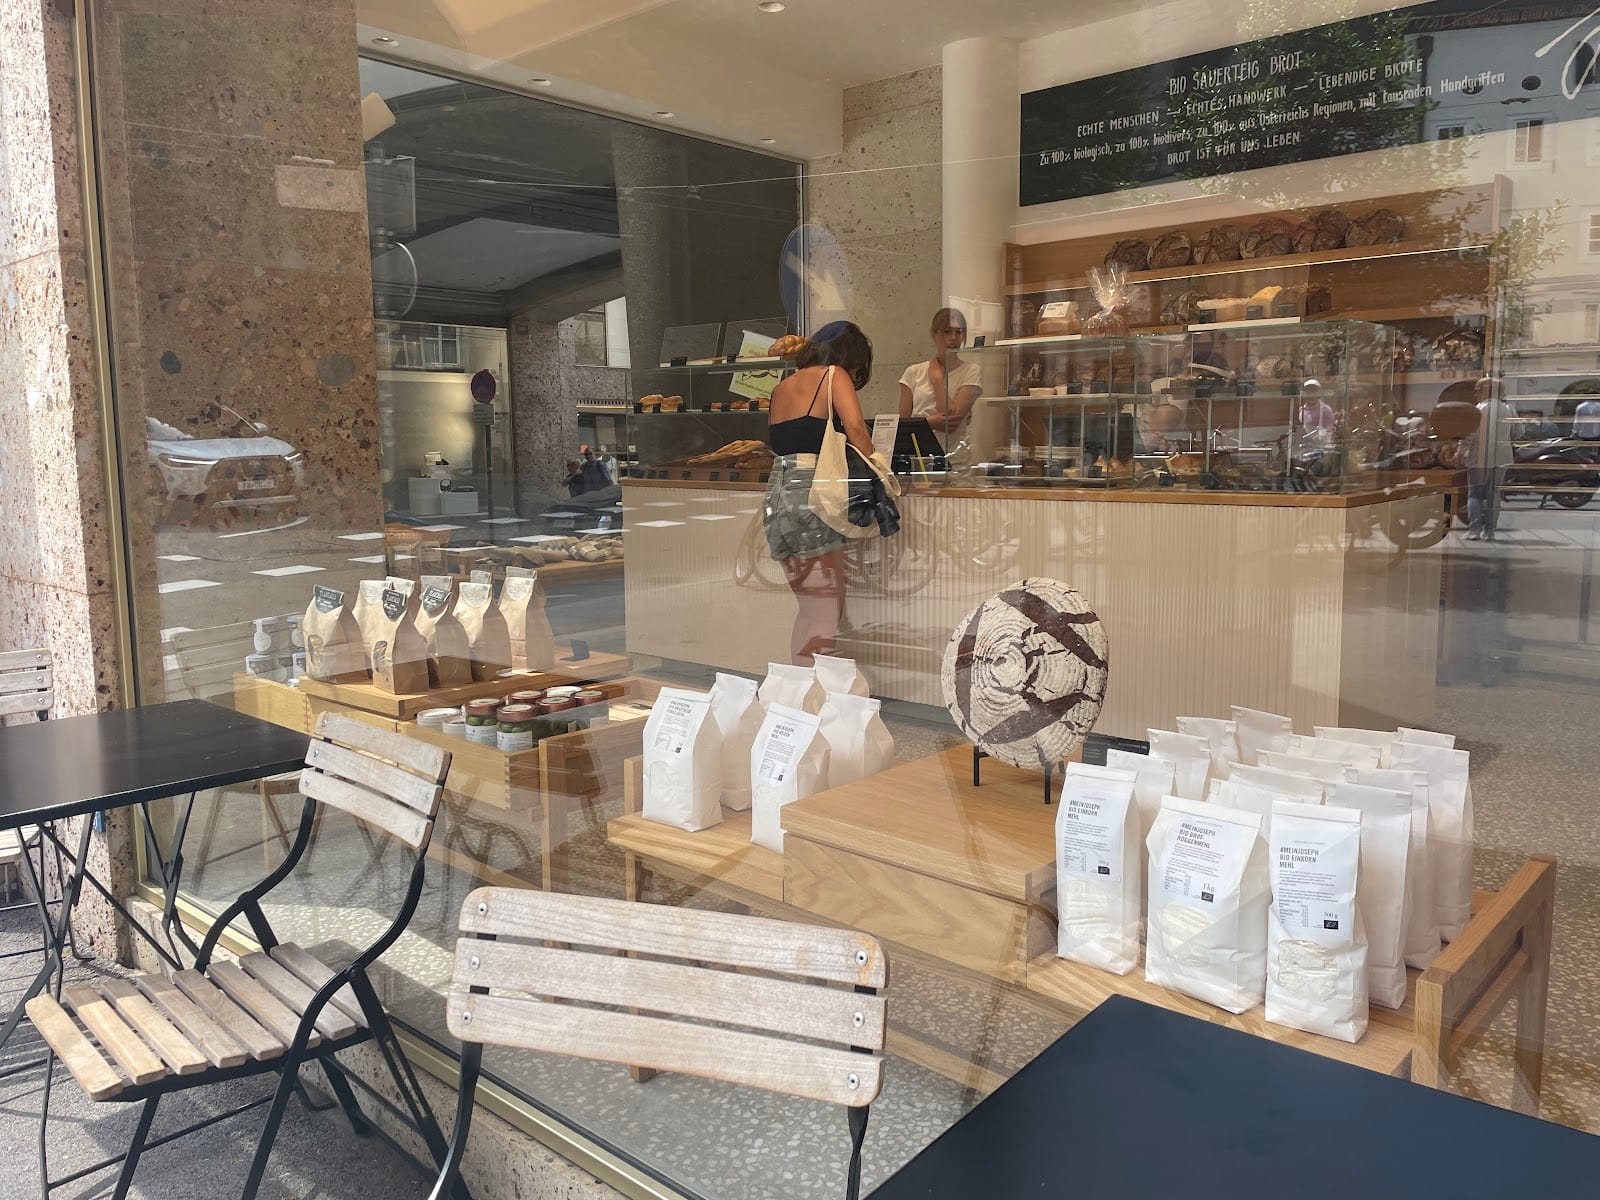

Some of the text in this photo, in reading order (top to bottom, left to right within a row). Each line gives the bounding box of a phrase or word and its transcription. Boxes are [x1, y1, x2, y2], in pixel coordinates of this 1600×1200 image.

[1169, 51, 1302, 96] BIO SAUERTEIG BROT
[1039, 153, 1049, 166] Zu
[1051, 150, 1072, 164] 100%
[1073, 142, 1113, 162] biologisch,
[1115, 143, 1126, 153] zu
[1129, 136, 1150, 150] 100%
[1238, 117, 1255, 132] aus
[1313, 99, 1357, 120] Regionen,
[1359, 92, 1377, 109] mit
[1382, 84, 1432, 104] tausenden
[1440, 70, 1505, 95] Handgriffen
[1077, 121, 1104, 138] ECHTE
[1110, 110, 1160, 131] MENSCHEN
[1186, 97, 1224, 117] ECHTES
[1228, 85, 1288, 108] HANDWERK
[1319, 67, 1377, 91] LEBENDIGE
[1167, 131, 1300, 166] BROT IST FÜR UNS LEBEN
[1280, 861, 1295, 869] MEHL
[1291, 855, 1317, 863] EINKORN
